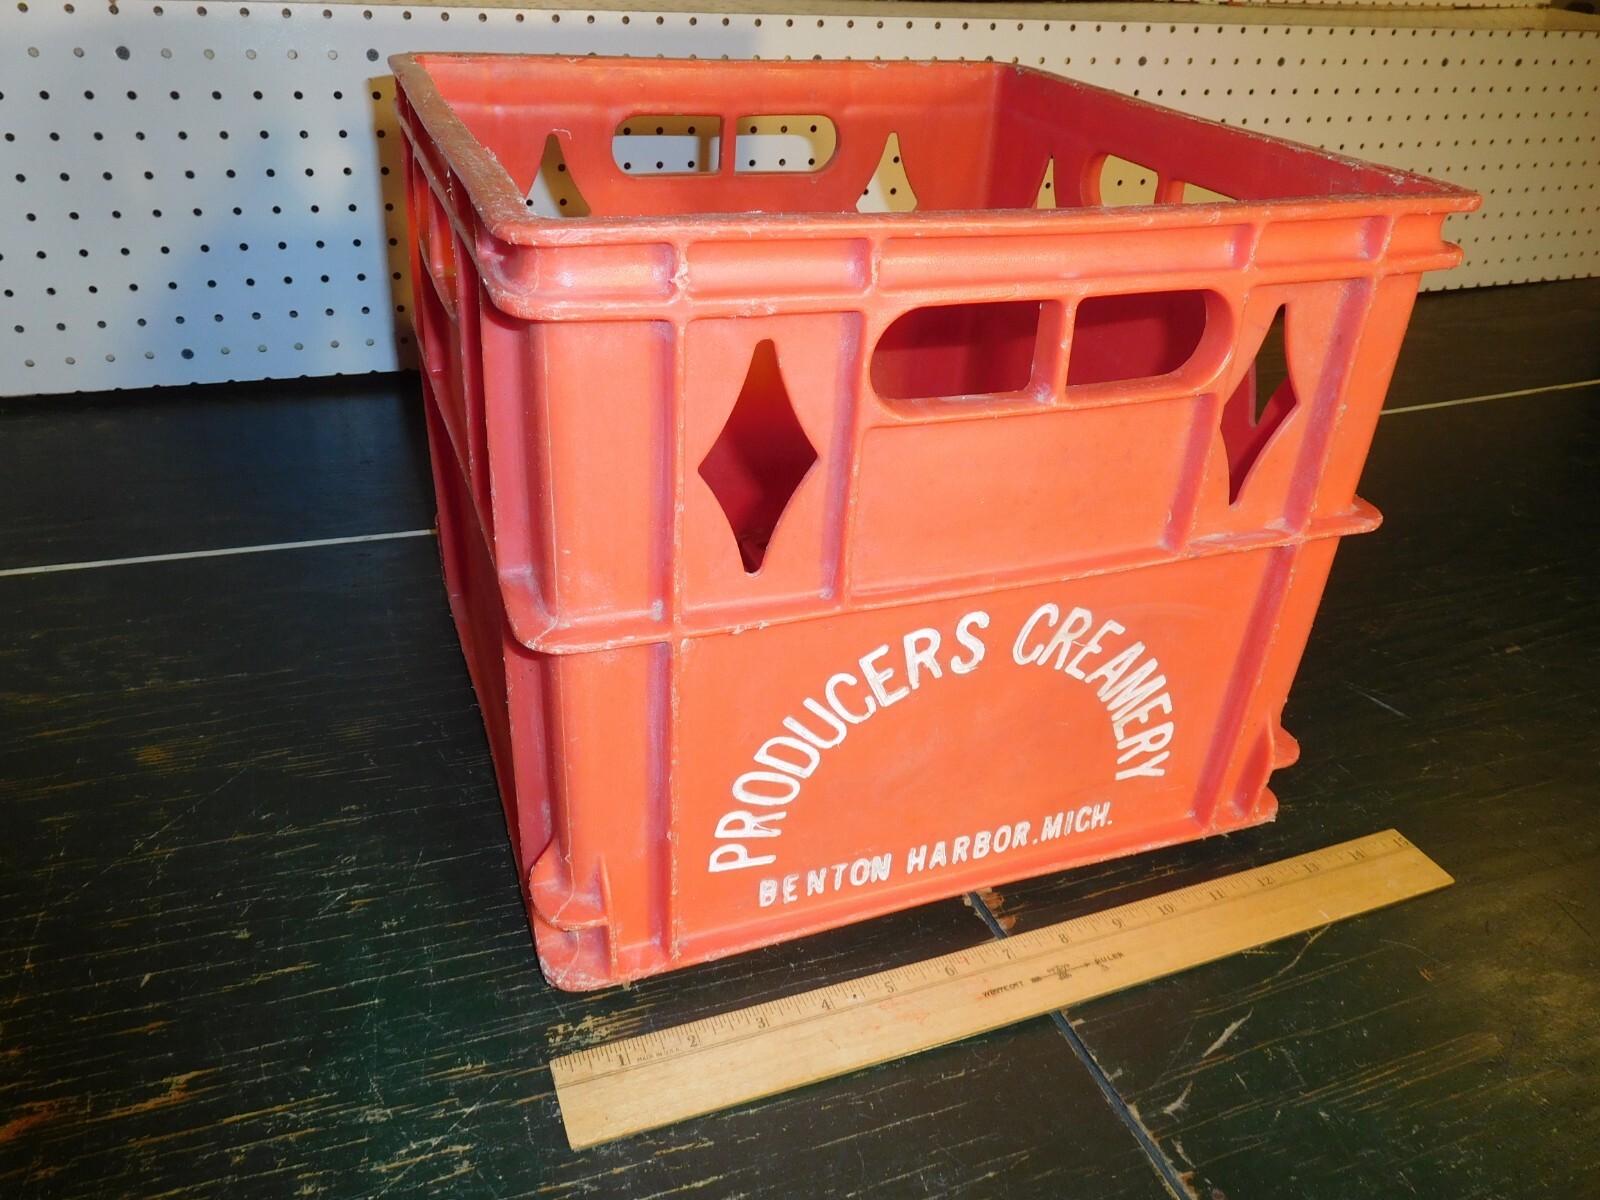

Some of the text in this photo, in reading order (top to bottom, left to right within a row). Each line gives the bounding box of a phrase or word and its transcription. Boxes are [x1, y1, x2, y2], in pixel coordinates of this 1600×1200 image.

[708, 602, 1175, 873] PRODUCERS CREAMERY
[616, 1054, 626, 1066] 1
[688, 1034, 699, 1047] 2
[755, 1016, 766, 1028] 3
[821, 999, 831, 1010] 4
[884, 981, 895, 993] 5
[945, 964, 956, 976] 6
[1001, 948, 1011, 959] 7
[1058, 933, 1069, 944] 8
[1112, 918, 1123, 928] 9
[1157, 903, 1174, 916] 10
[1209, 890, 1224, 901] 11
[1257, 876, 1273, 887] 12
[1303, 862, 1320, 873] 13
[759, 853, 892, 907] BENTON
